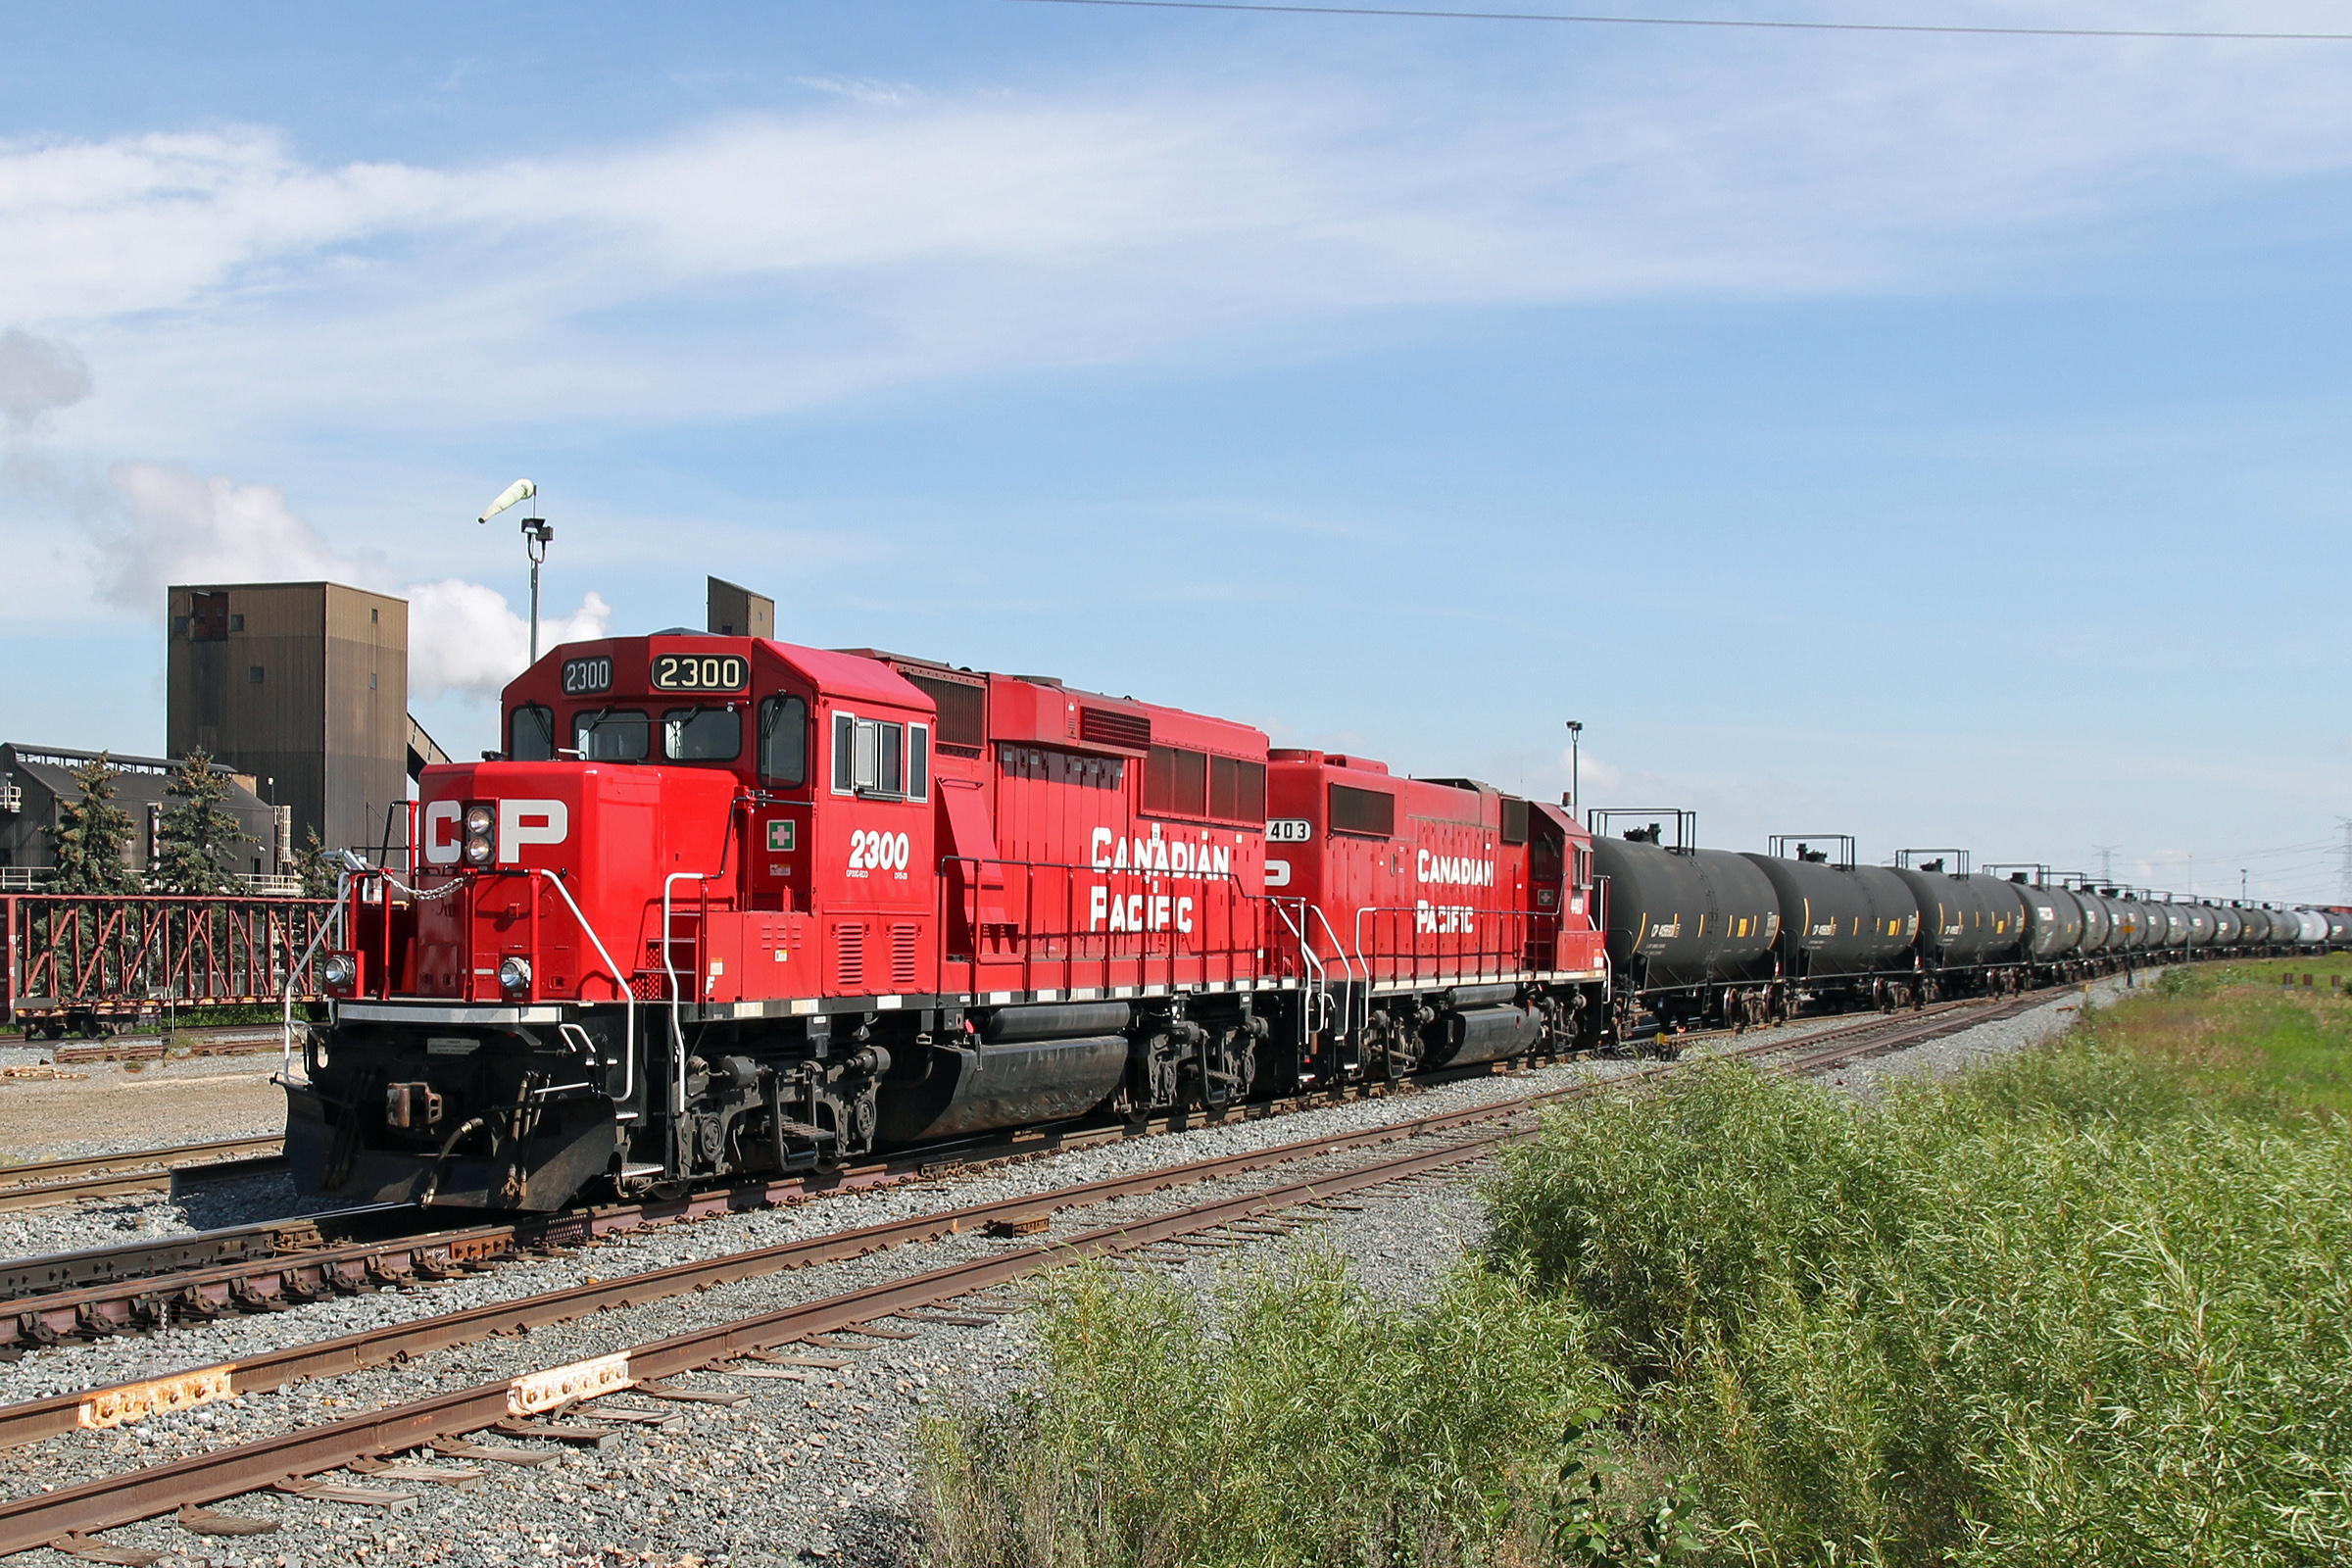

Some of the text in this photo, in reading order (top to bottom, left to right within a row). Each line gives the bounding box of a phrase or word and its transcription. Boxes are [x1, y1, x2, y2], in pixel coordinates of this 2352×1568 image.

[566, 661, 609, 691] 2300
[660, 658, 740, 688] 2300
[425, 799, 568, 864] CP
[1271, 821, 1306, 839] 403
[848, 829, 909, 871] 2300
[1092, 826, 1230, 881] CANADIAN
[1417, 849, 1494, 888] CANADIAN
[1416, 899, 1474, 934] PACIFIC
[706, 975, 715, 995] F
